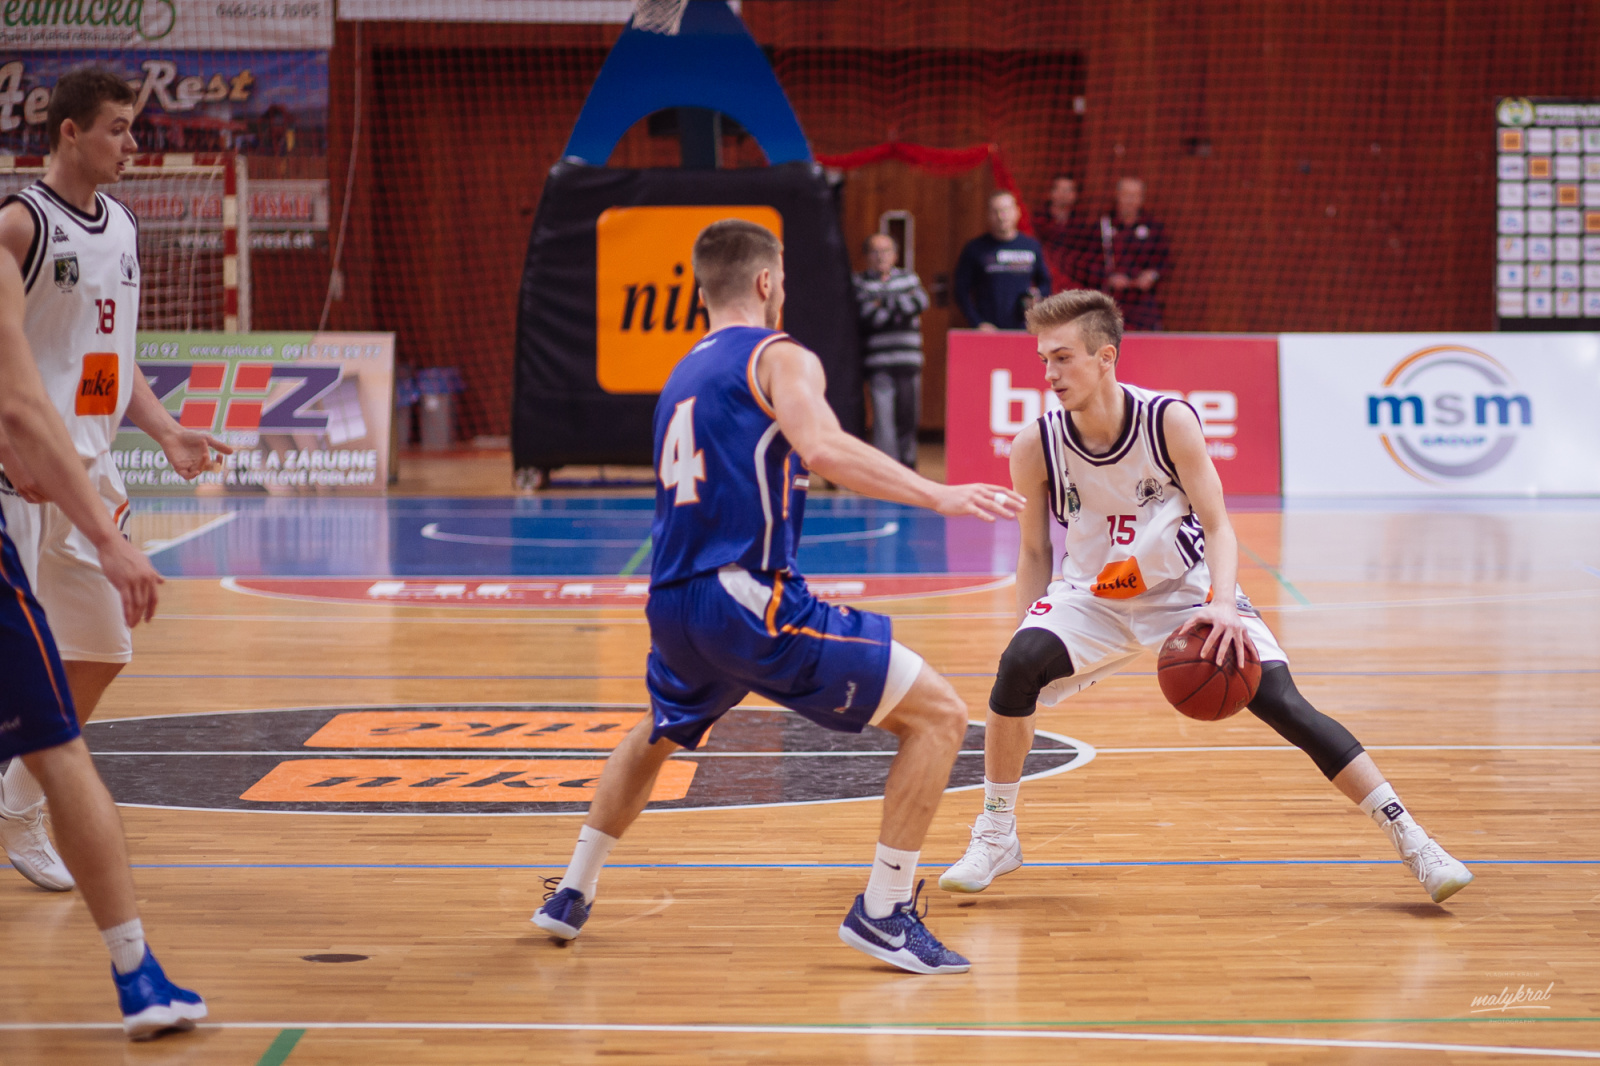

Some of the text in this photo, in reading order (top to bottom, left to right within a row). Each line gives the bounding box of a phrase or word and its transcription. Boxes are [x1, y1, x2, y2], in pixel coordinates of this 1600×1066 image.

[95, 298, 116, 335] 18
[1367, 393, 1532, 427] msm
[266, 450, 281, 470] A
[284, 446, 377, 470] ZÁRUBNE
[659, 396, 707, 506] 4
[1106, 515, 1137, 547] 15
